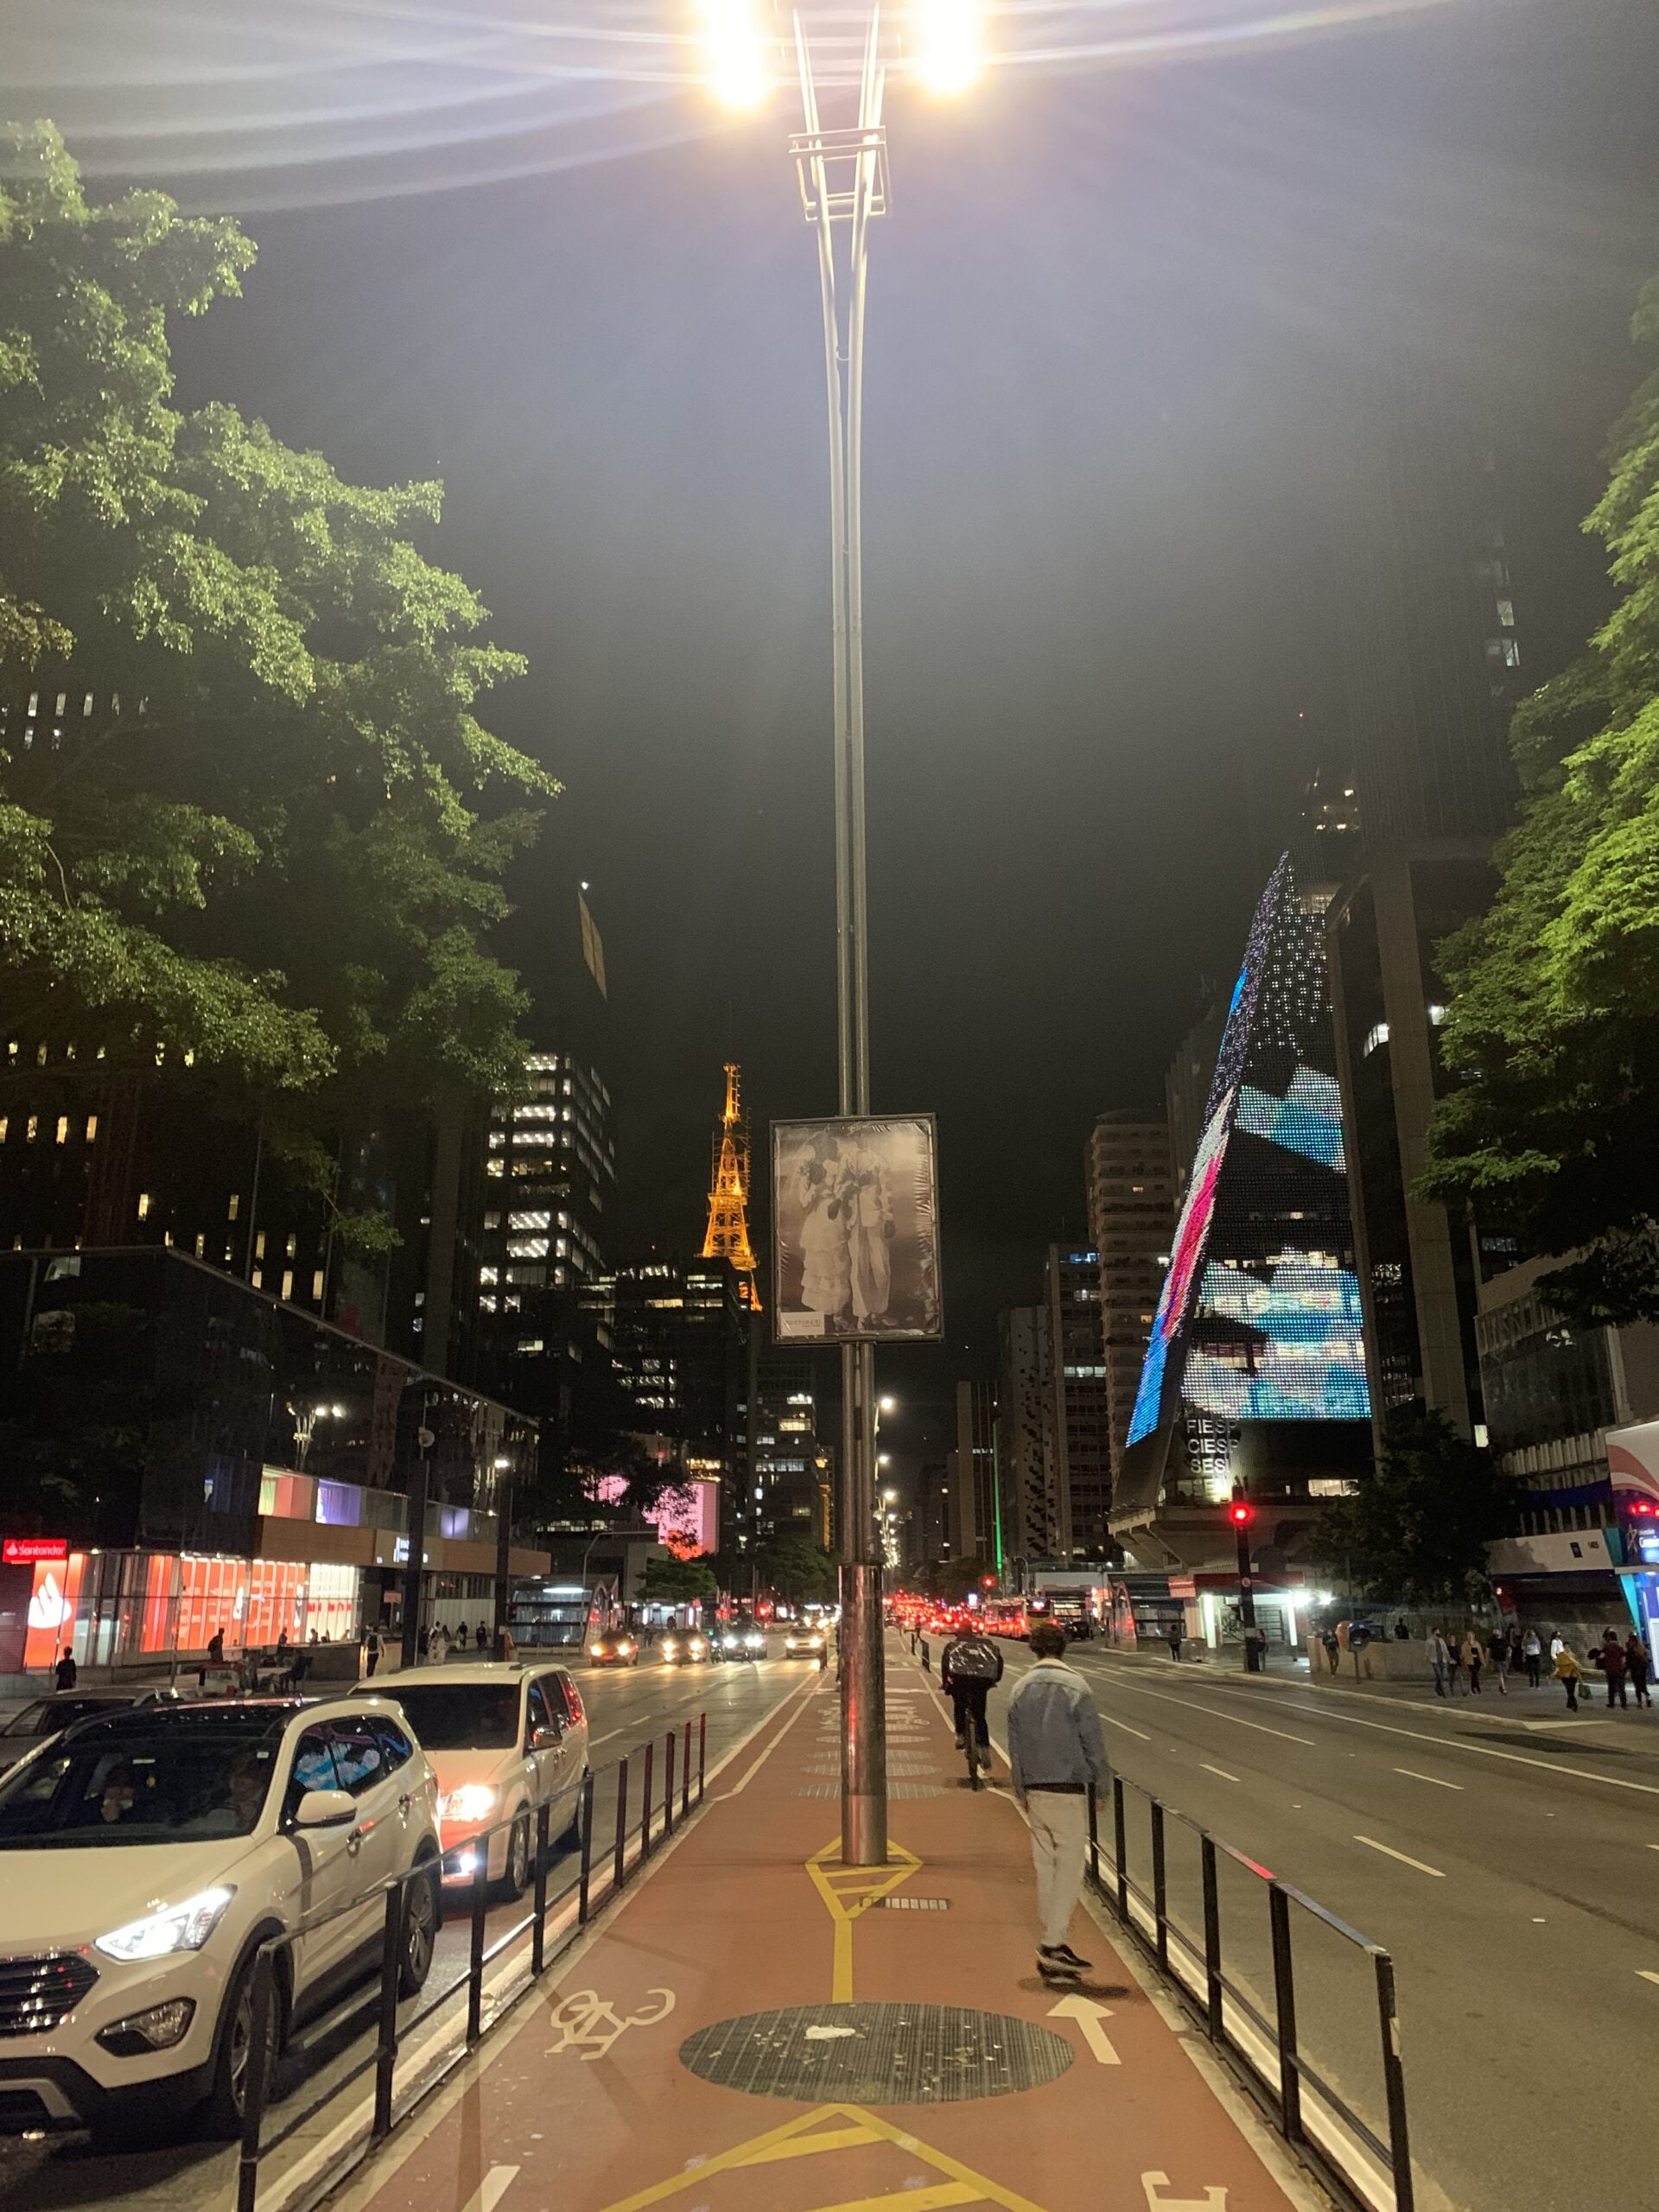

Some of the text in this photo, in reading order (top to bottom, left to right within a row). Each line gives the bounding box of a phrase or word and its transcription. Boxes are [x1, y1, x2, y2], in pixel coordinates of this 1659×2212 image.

[1186, 1419, 1237, 1433] FIESP
[1187, 1439, 1239, 1453] CIESP
[1191, 1458, 1230, 1473] SESI
[19, 1544, 64, 1555] Santander
